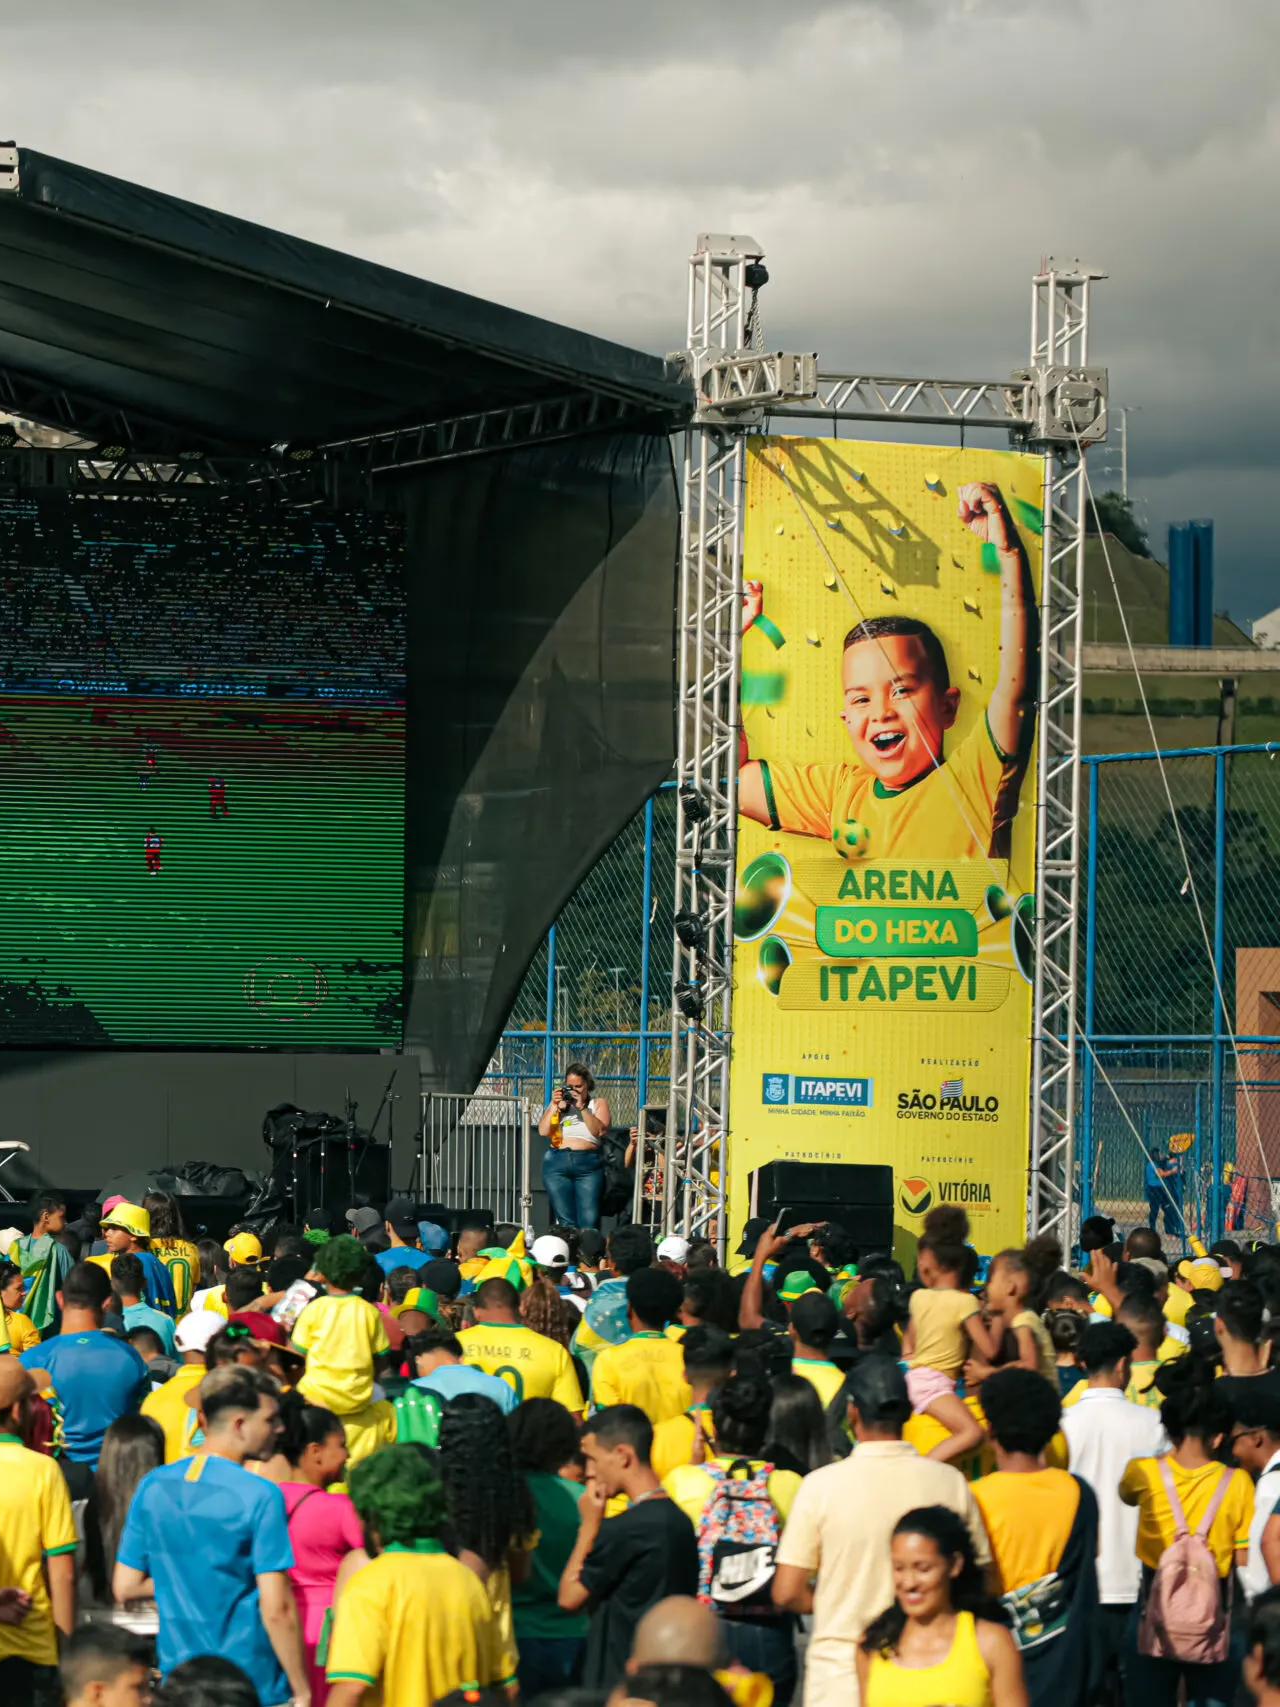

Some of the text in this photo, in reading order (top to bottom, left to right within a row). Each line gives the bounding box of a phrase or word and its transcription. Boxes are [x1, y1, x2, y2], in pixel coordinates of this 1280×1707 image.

[837, 869, 959, 901] ARENA
[834, 919, 958, 945] DO HEXA
[819, 964, 977, 1002] ITAPEVI
[801, 1053, 831, 1061] APOIO
[920, 1057, 980, 1067] REALIZAÇÃO
[800, 1080, 862, 1098] ITAPEVI
[897, 1089, 999, 1112] SÃO PAULO
[896, 1110, 999, 1123] GOVERNO DO ESTADO
[938, 1178, 992, 1203] VITÓRIA
